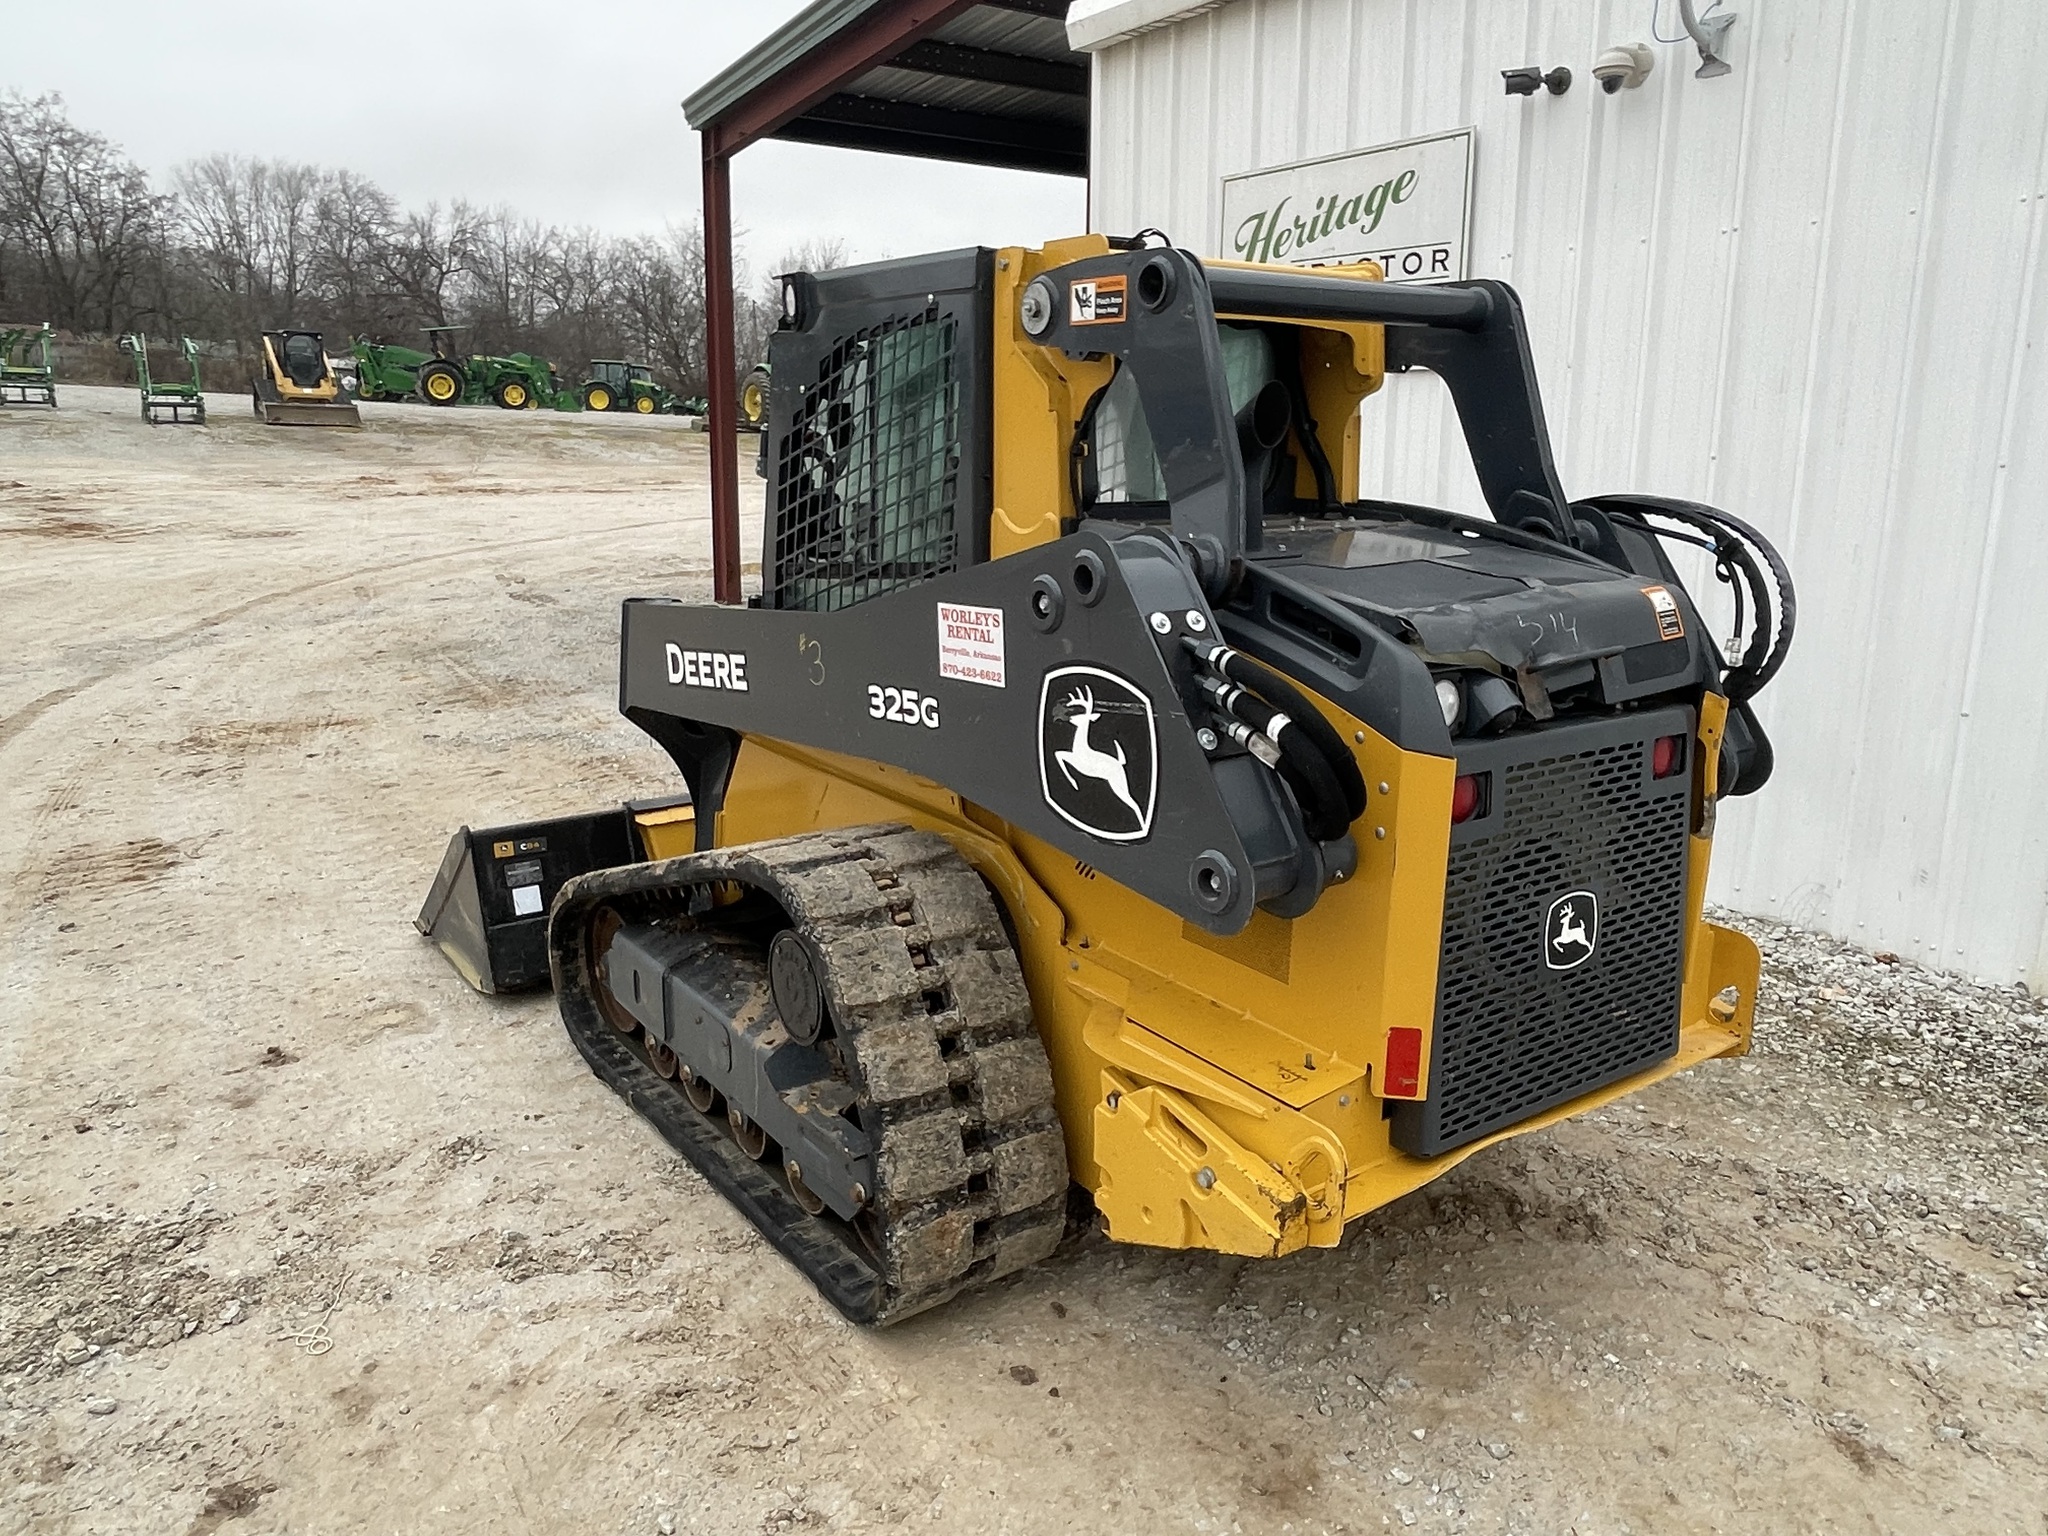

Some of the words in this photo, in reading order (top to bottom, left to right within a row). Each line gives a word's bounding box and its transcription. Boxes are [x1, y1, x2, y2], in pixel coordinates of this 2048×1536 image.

[1235, 169, 1420, 263] Heritage
[947, 624, 994, 643] RENTAL
[665, 643, 748, 691] DEERE
[867, 684, 940, 729] 325G
